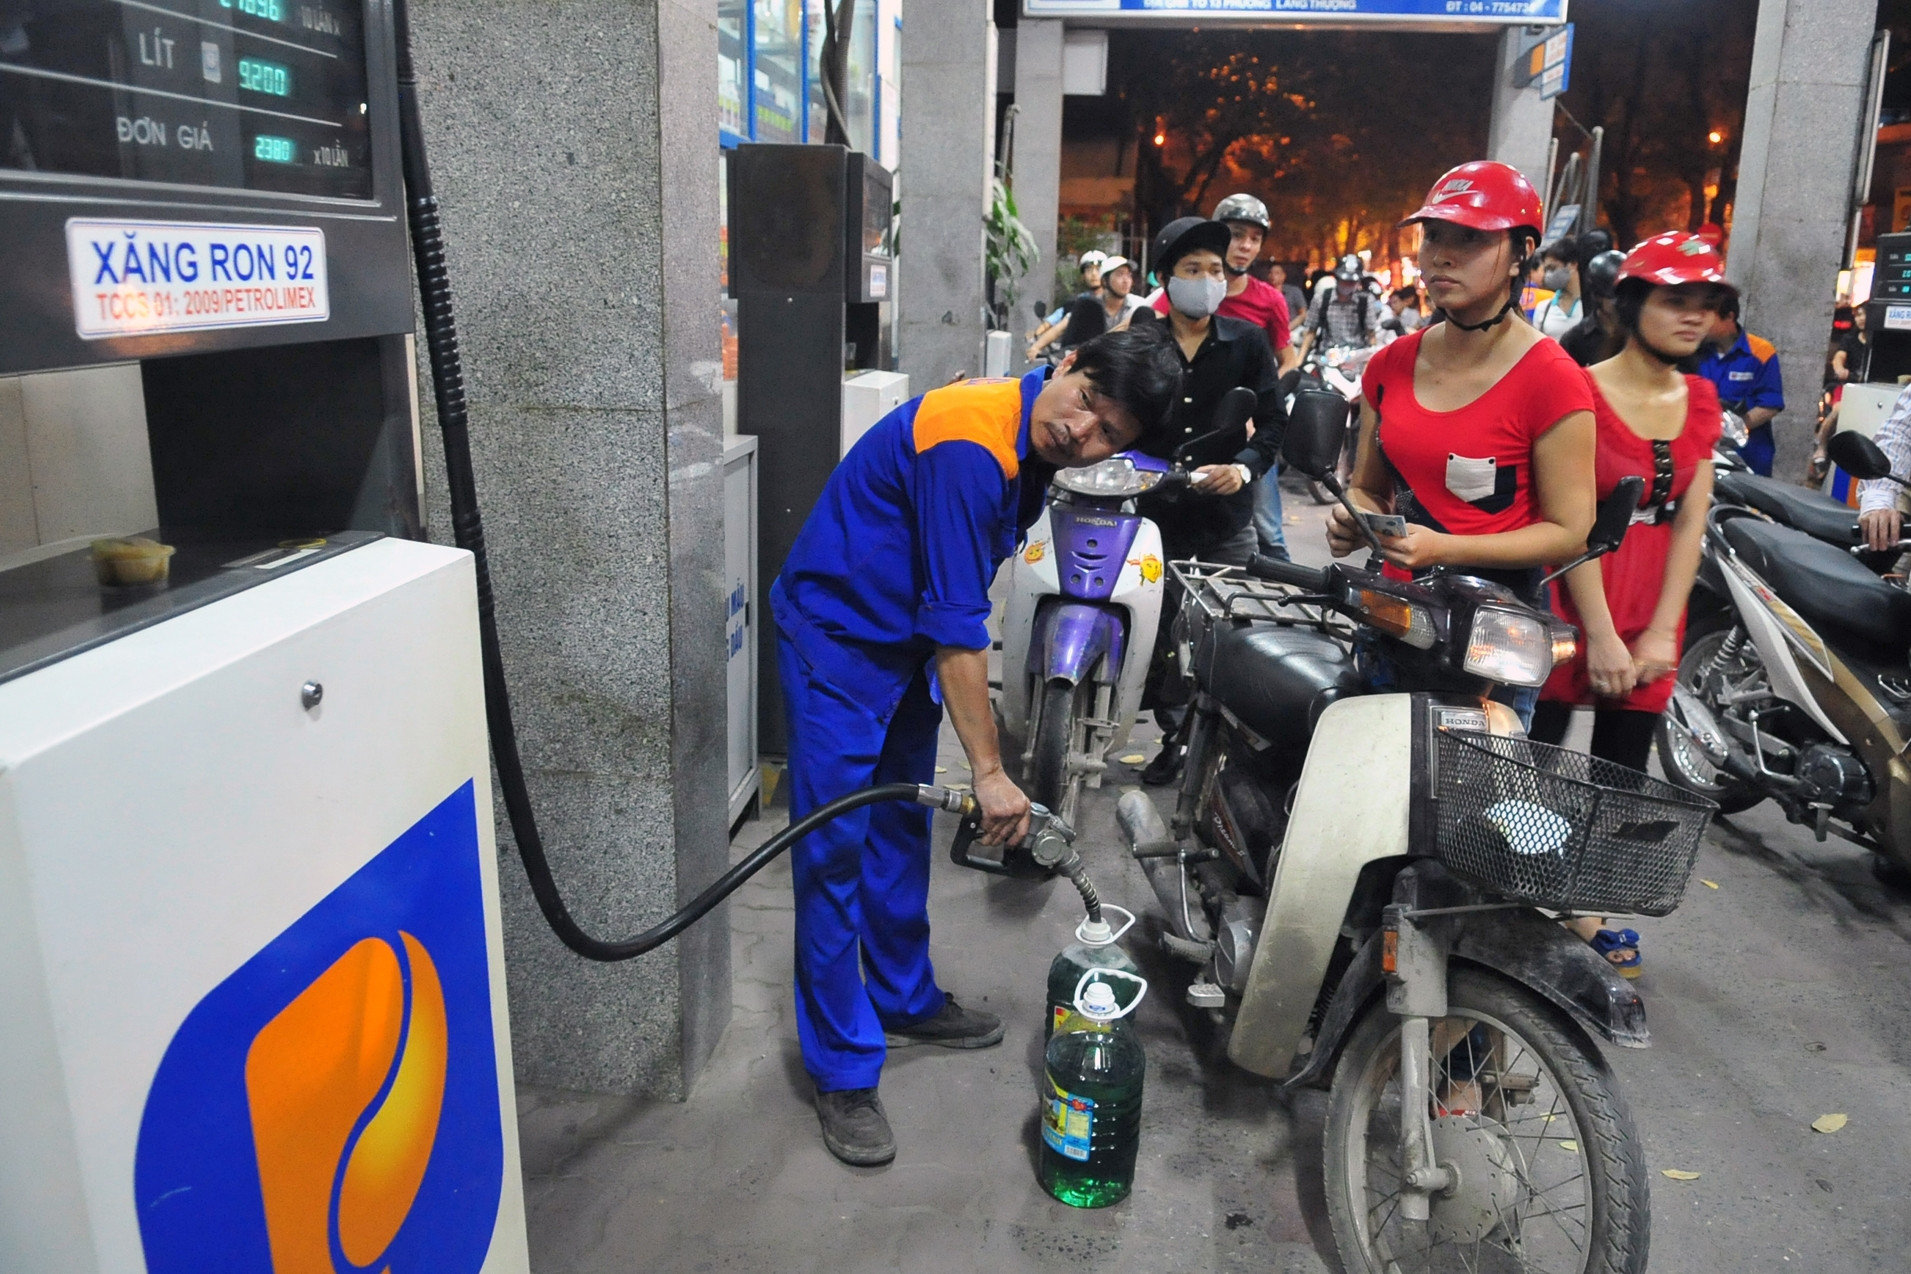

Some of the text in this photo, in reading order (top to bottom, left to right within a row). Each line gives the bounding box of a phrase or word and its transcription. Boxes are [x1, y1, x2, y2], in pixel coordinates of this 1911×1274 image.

[139, 27, 175, 69] LÍT
[116, 116, 213, 151] ĐƠN GIÁ
[91, 230, 314, 285] XĂNG RON 92
[95, 291, 151, 321] TCCS
[185, 286, 316, 315] 2009/PETROLIMEX
[1445, 718, 1486, 727] HONDA
